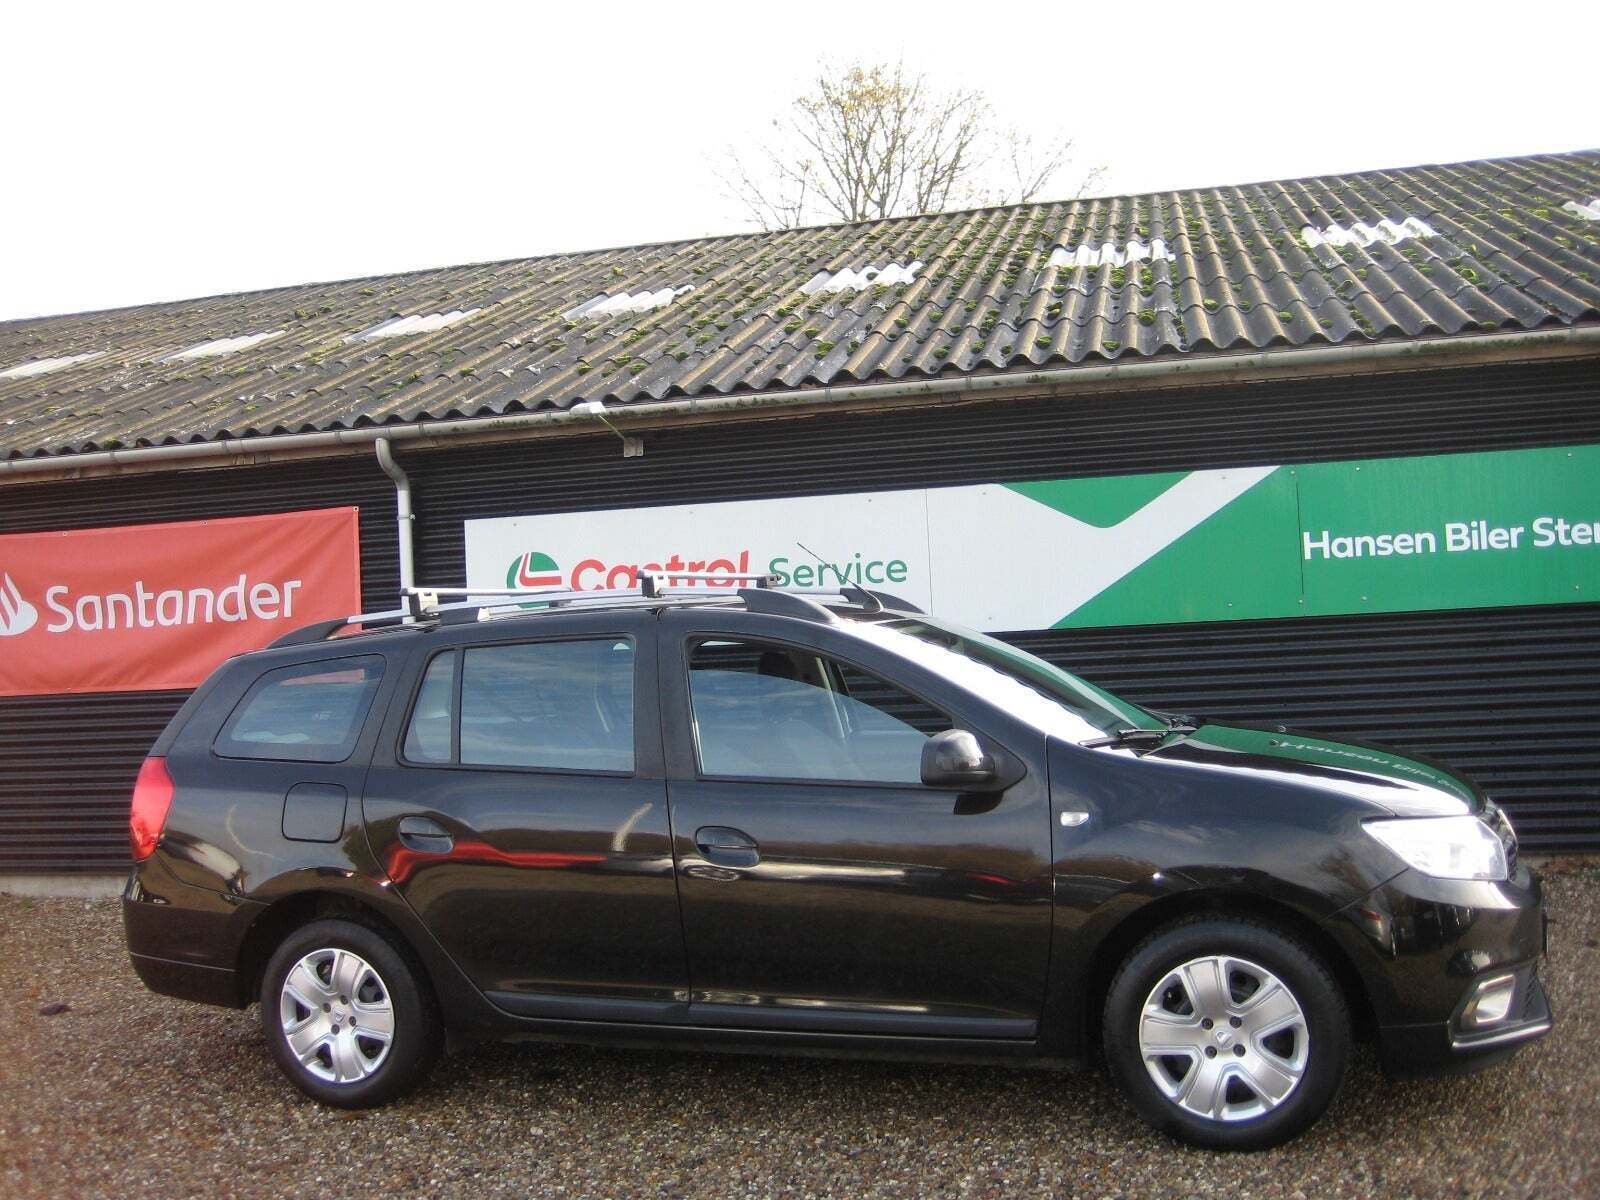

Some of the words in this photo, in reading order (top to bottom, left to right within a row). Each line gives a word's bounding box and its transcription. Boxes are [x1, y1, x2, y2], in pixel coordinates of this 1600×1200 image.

[1303, 530, 1436, 560] Hansen
[1445, 520, 1525, 552] Biler
[768, 552, 908, 588] Service
[46, 573, 302, 633] Santander
